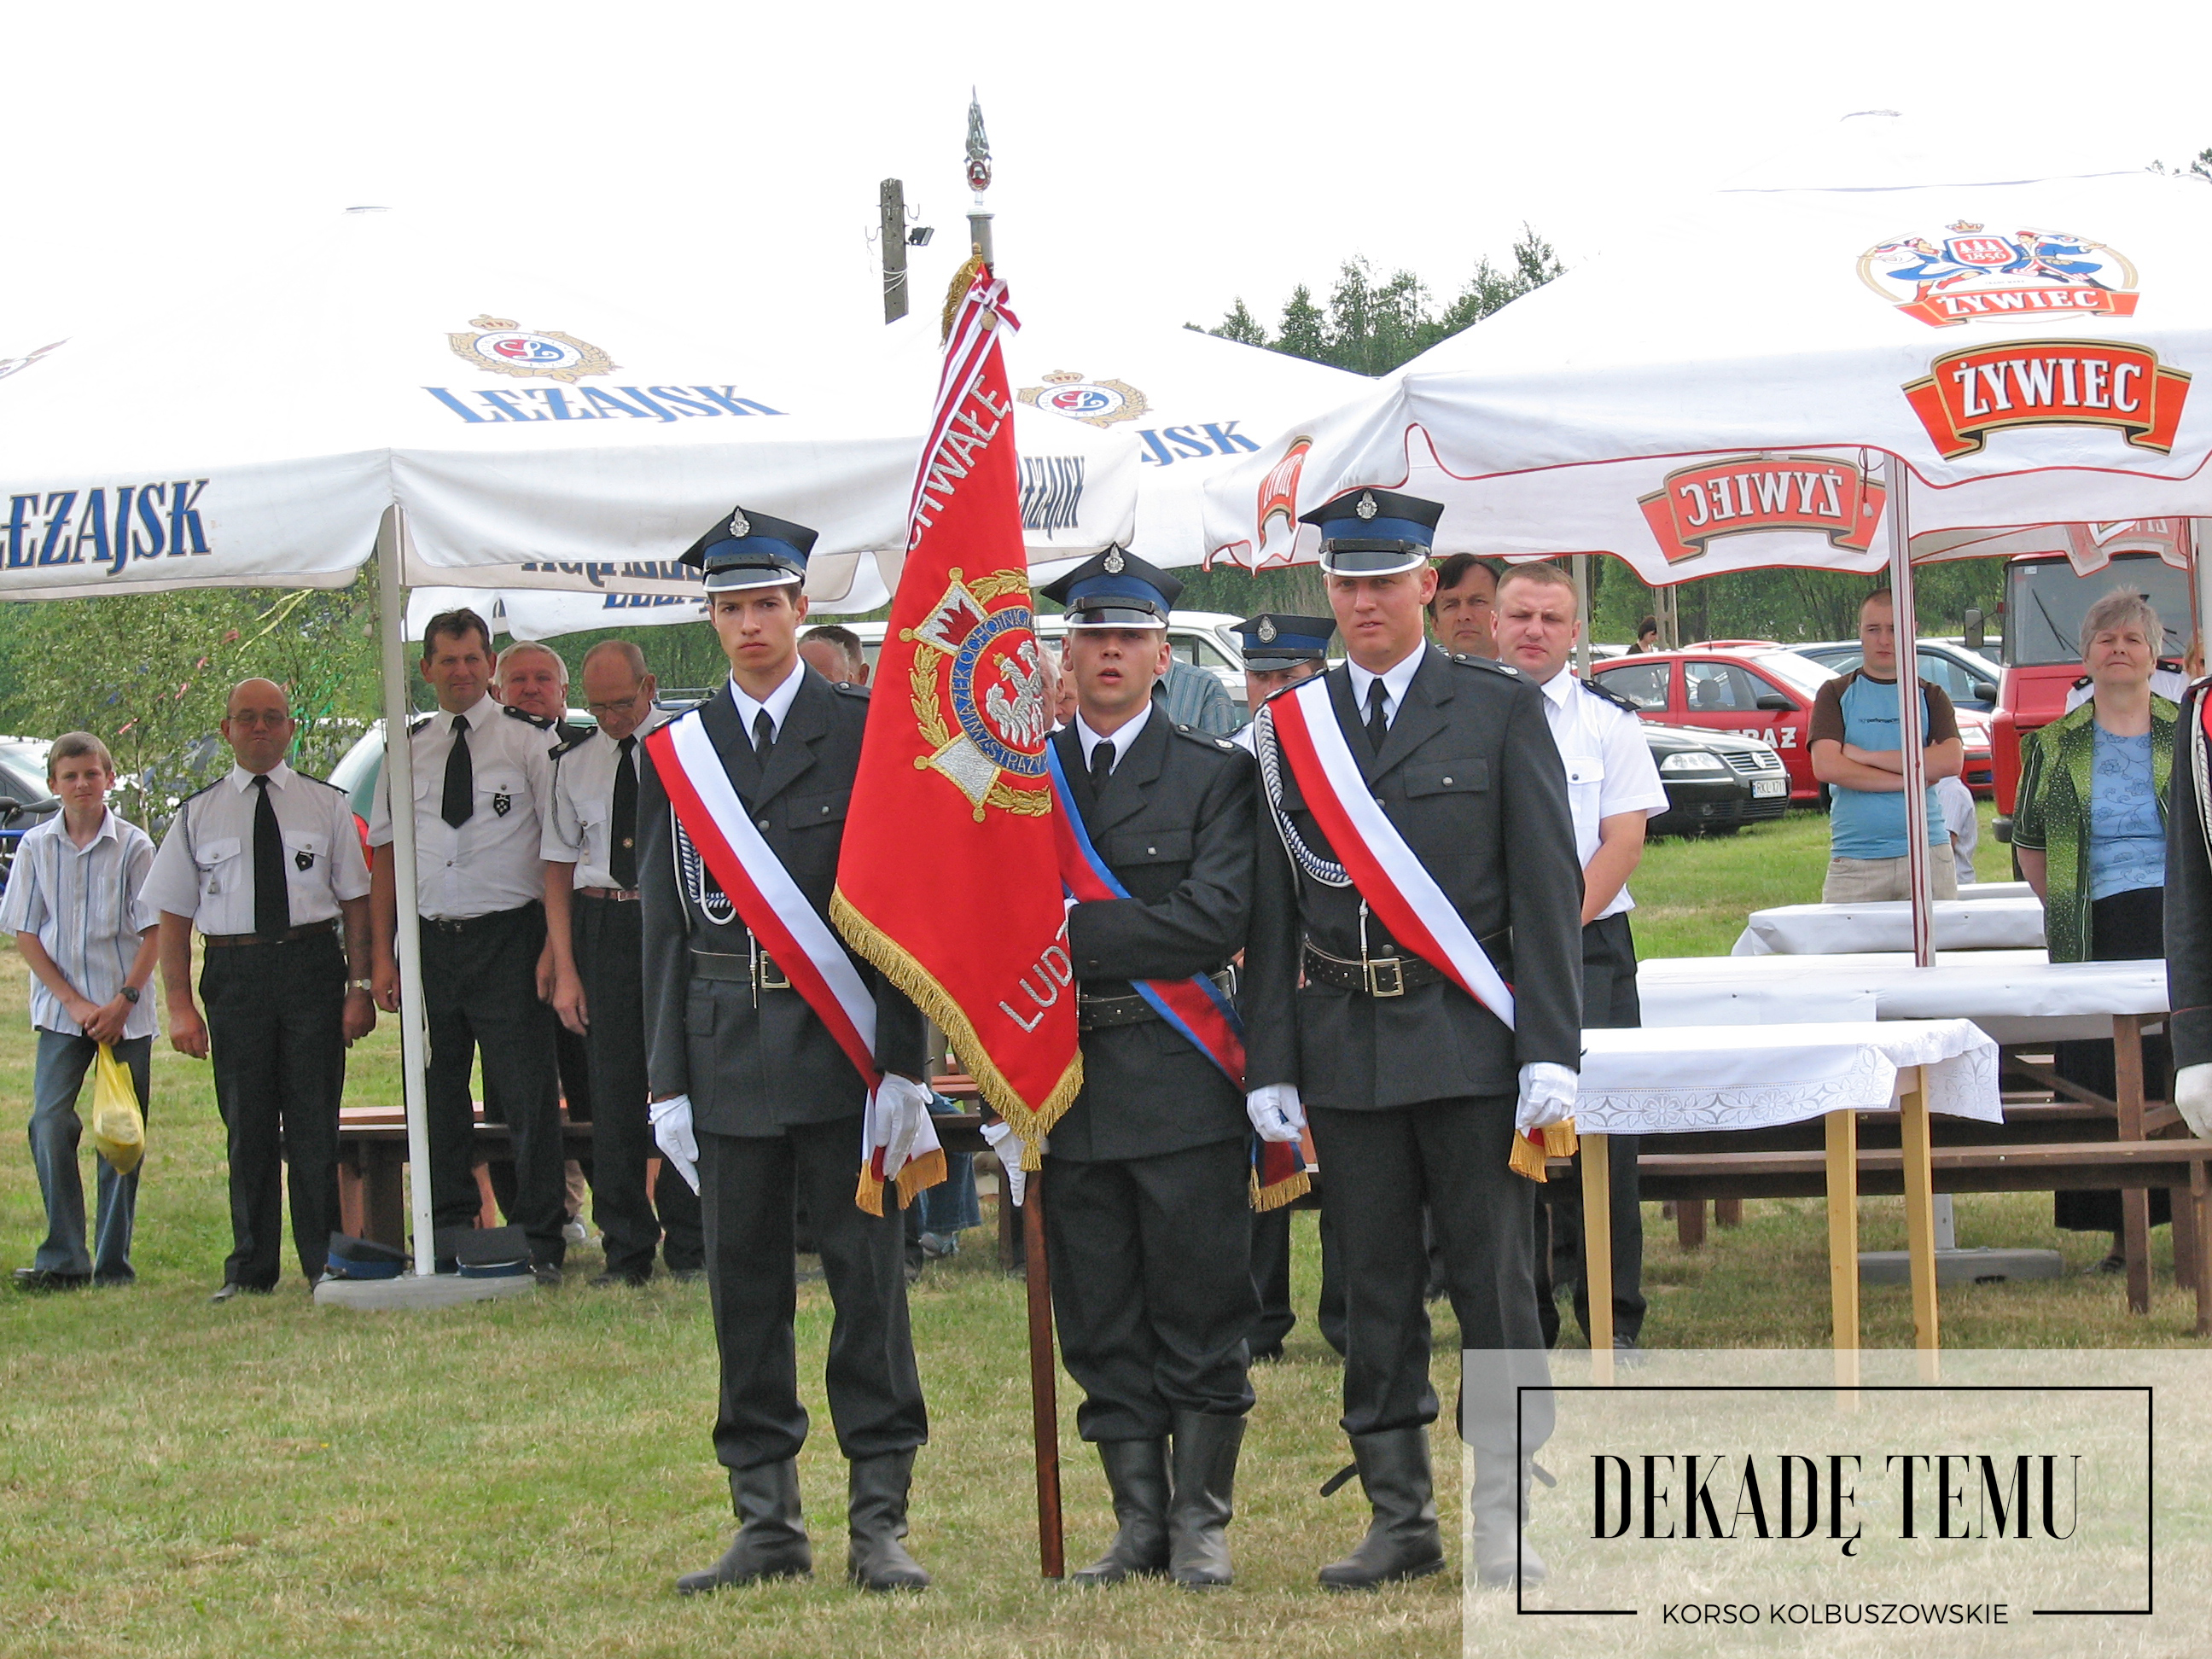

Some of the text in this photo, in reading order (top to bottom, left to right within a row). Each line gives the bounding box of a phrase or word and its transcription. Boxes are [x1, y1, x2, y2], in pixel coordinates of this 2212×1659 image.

[1965, 252, 2007, 263] 1856
[1936, 289, 2100, 316] ŻYWIEC
[419, 385, 790, 423] LEŻAJSK
[1953, 357, 2143, 420] ŻYWIEC
[1016, 451, 1086, 542] EŻAJSK
[0, 478, 212, 577] EŻAJSK
